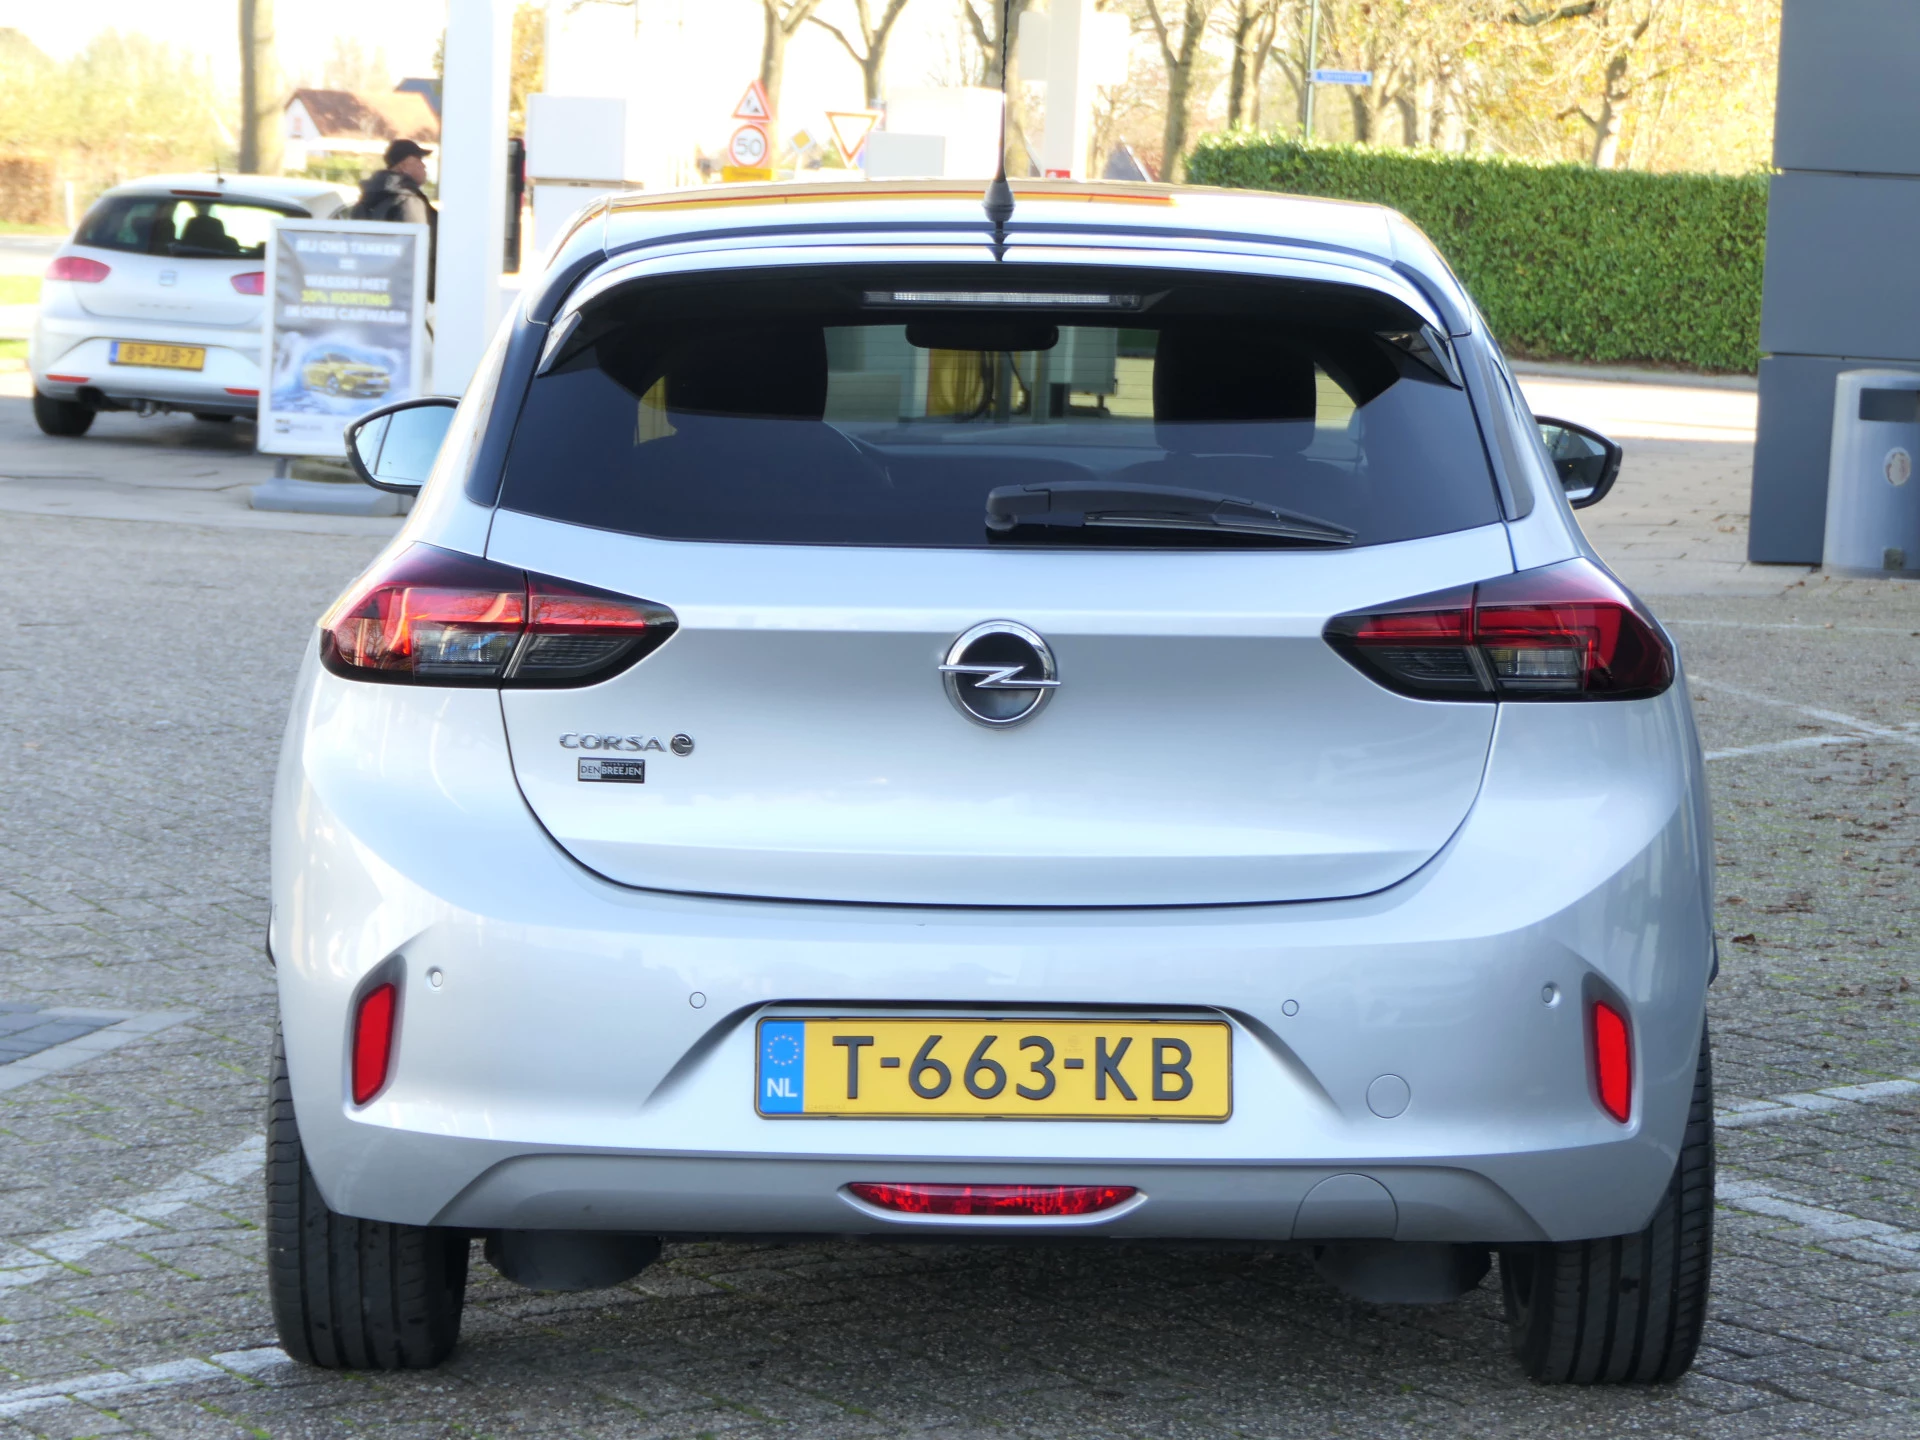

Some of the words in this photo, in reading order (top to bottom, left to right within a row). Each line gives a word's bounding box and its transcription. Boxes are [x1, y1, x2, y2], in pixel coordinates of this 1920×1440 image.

[735, 138, 763, 157] 50
[304, 274, 360, 290] WASSEN
[361, 277, 390, 291] MET
[330, 291, 392, 307] KORTING
[337, 307, 407, 324] CARWASH
[559, 732, 667, 752] CORSA
[580, 765, 600, 774] DEN
[601, 766, 641, 776] BREEJEN
[832, 1034, 1194, 1101] T-663-KB
[766, 1077, 797, 1098] NL
